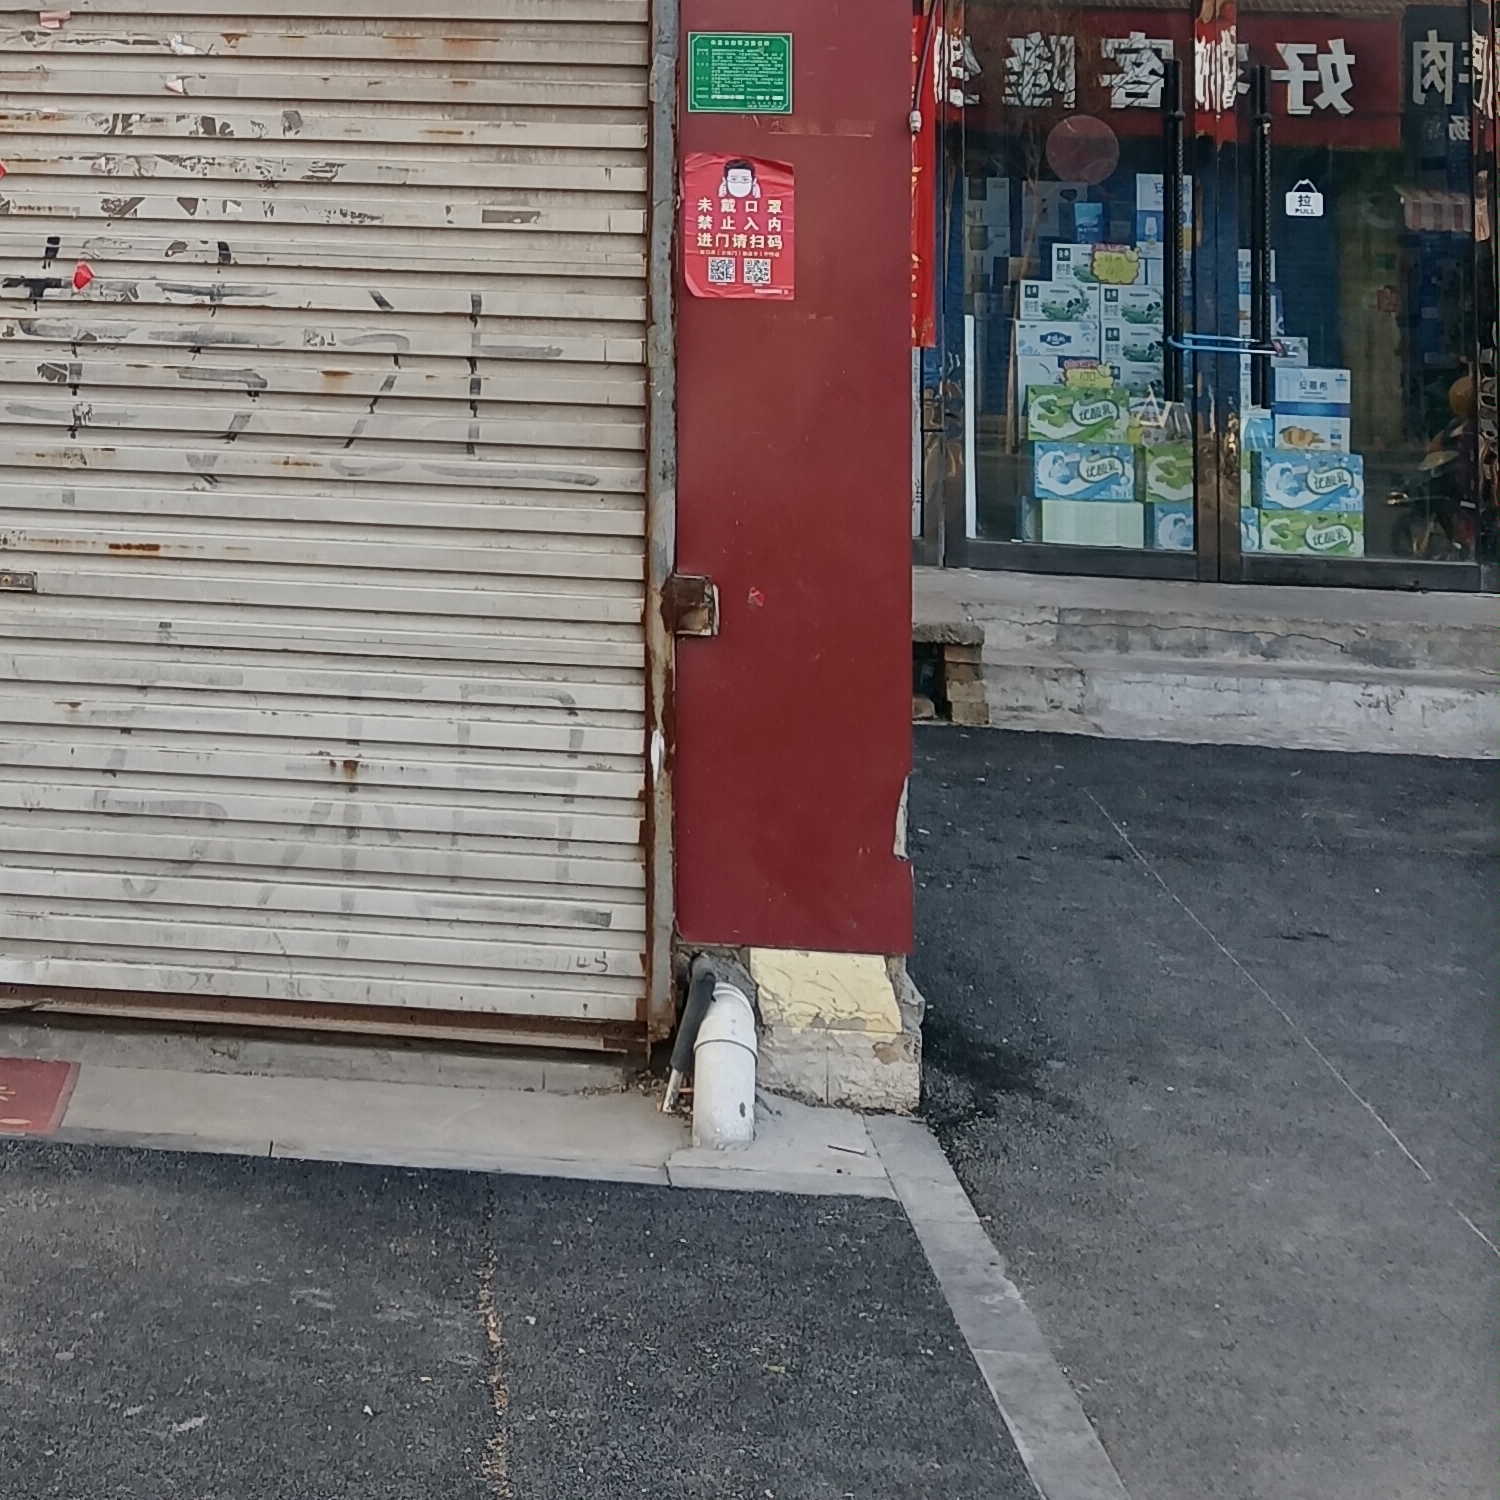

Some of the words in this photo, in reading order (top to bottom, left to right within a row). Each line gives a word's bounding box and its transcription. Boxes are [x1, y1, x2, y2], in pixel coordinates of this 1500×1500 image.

[697, 197, 783, 214] 未戴口罩
[1297, 194, 1312, 207] 拉
[697, 215, 782, 232] 禁止入内
[697, 233, 783, 249] 进门请扫码
[1079, 404, 1113, 421] 优酸乳
[1086, 460, 1119, 478] 优酸乳
[1313, 471, 1348, 489] 优酸乳
[1312, 528, 1347, 546] 优酸乳
